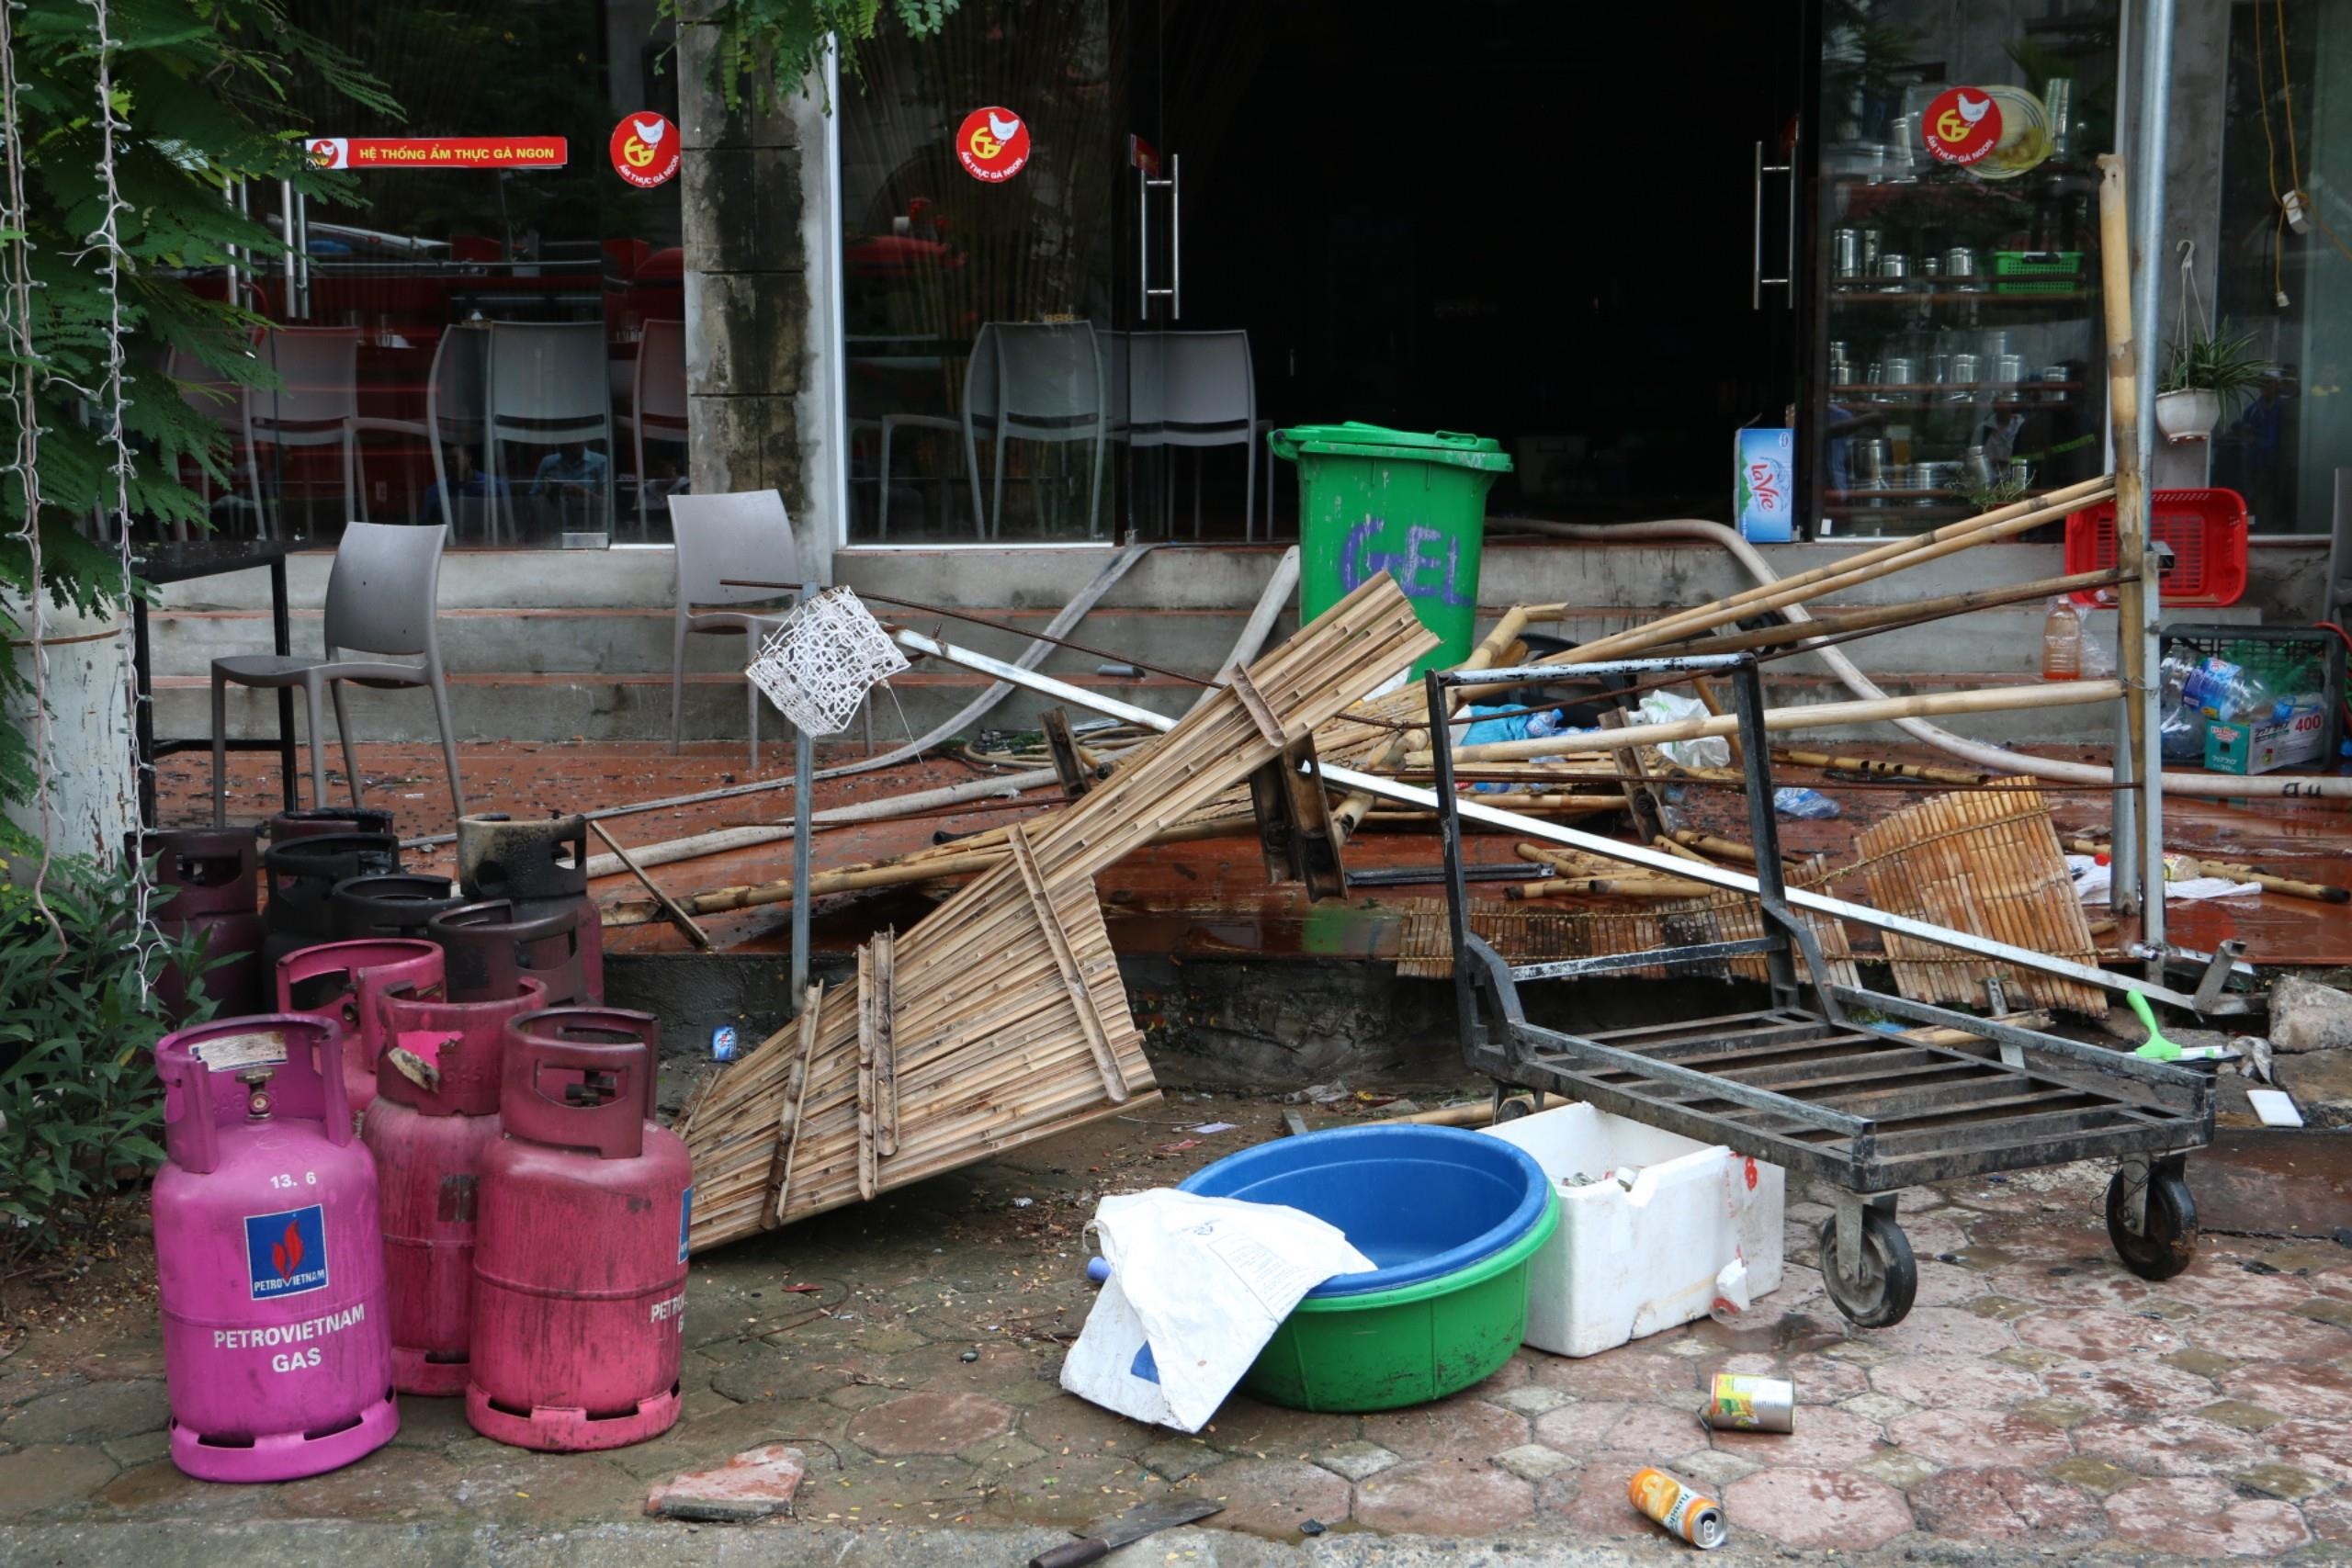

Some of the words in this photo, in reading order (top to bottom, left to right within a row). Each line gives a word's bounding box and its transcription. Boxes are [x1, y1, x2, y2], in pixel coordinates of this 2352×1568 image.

[359, 146, 377, 162] HỆ
[380, 145, 426, 160] THỐNG
[430, 143, 452, 160] ẨM
[455, 147, 490, 162] THỰC
[493, 146, 513, 159] GÀ
[516, 148, 555, 159] NGON
[1973, 139, 1995, 161] NGON
[653, 172, 666, 183] GÀ
[663, 154, 680, 177] NGON
[990, 170, 1003, 179] GÀ
[1003, 157, 1023, 176] NGON
[2294, 714, 2322, 733] 400
[254, 1269, 325, 1292] PETROVIETNAM
[213, 1303, 365, 1348] PETROVIETNAM
[272, 1347, 322, 1373] GAS
